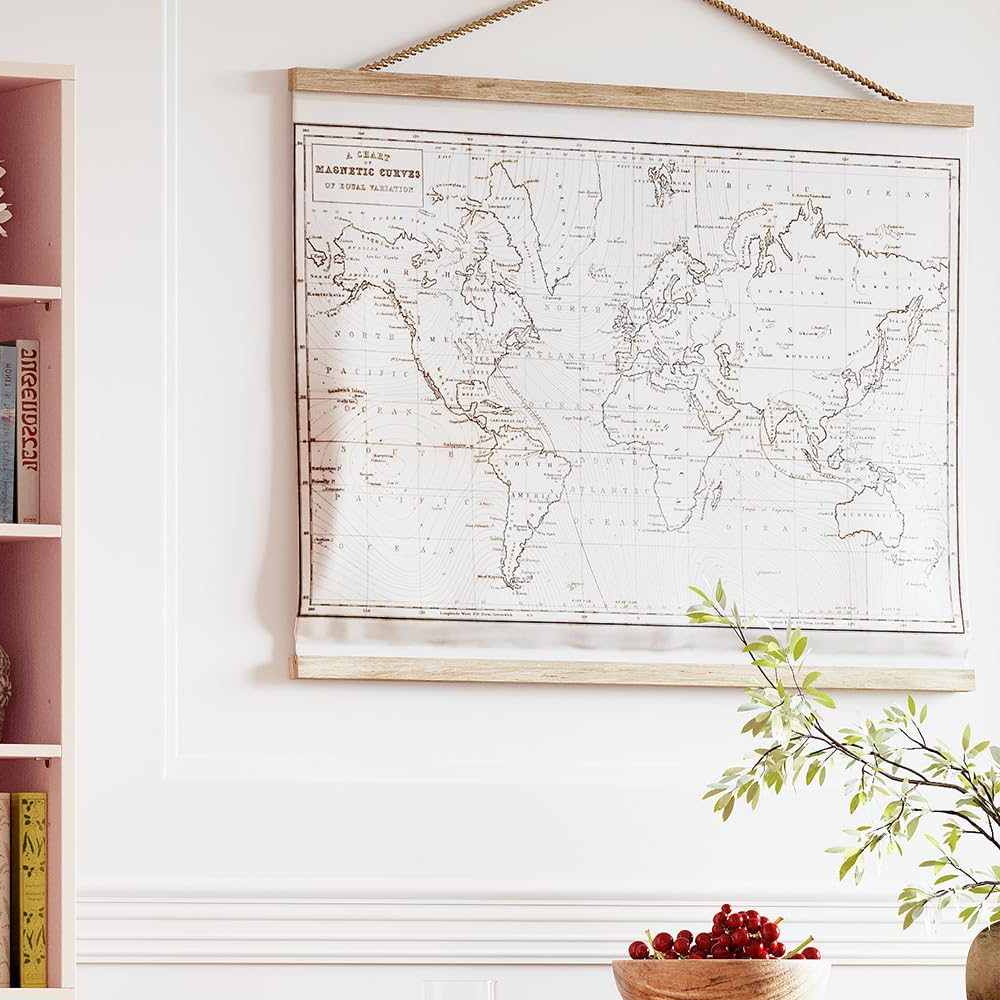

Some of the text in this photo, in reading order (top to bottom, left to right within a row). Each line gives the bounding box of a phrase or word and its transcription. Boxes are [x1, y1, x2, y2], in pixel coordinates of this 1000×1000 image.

[346, 150, 391, 161] A CHART
[314, 164, 421, 179] MAGNETIC CURVES
[324, 181, 336, 189] OF
[339, 183, 366, 191] EQUAL
[841, 511, 901, 520] AUSTRALIA
